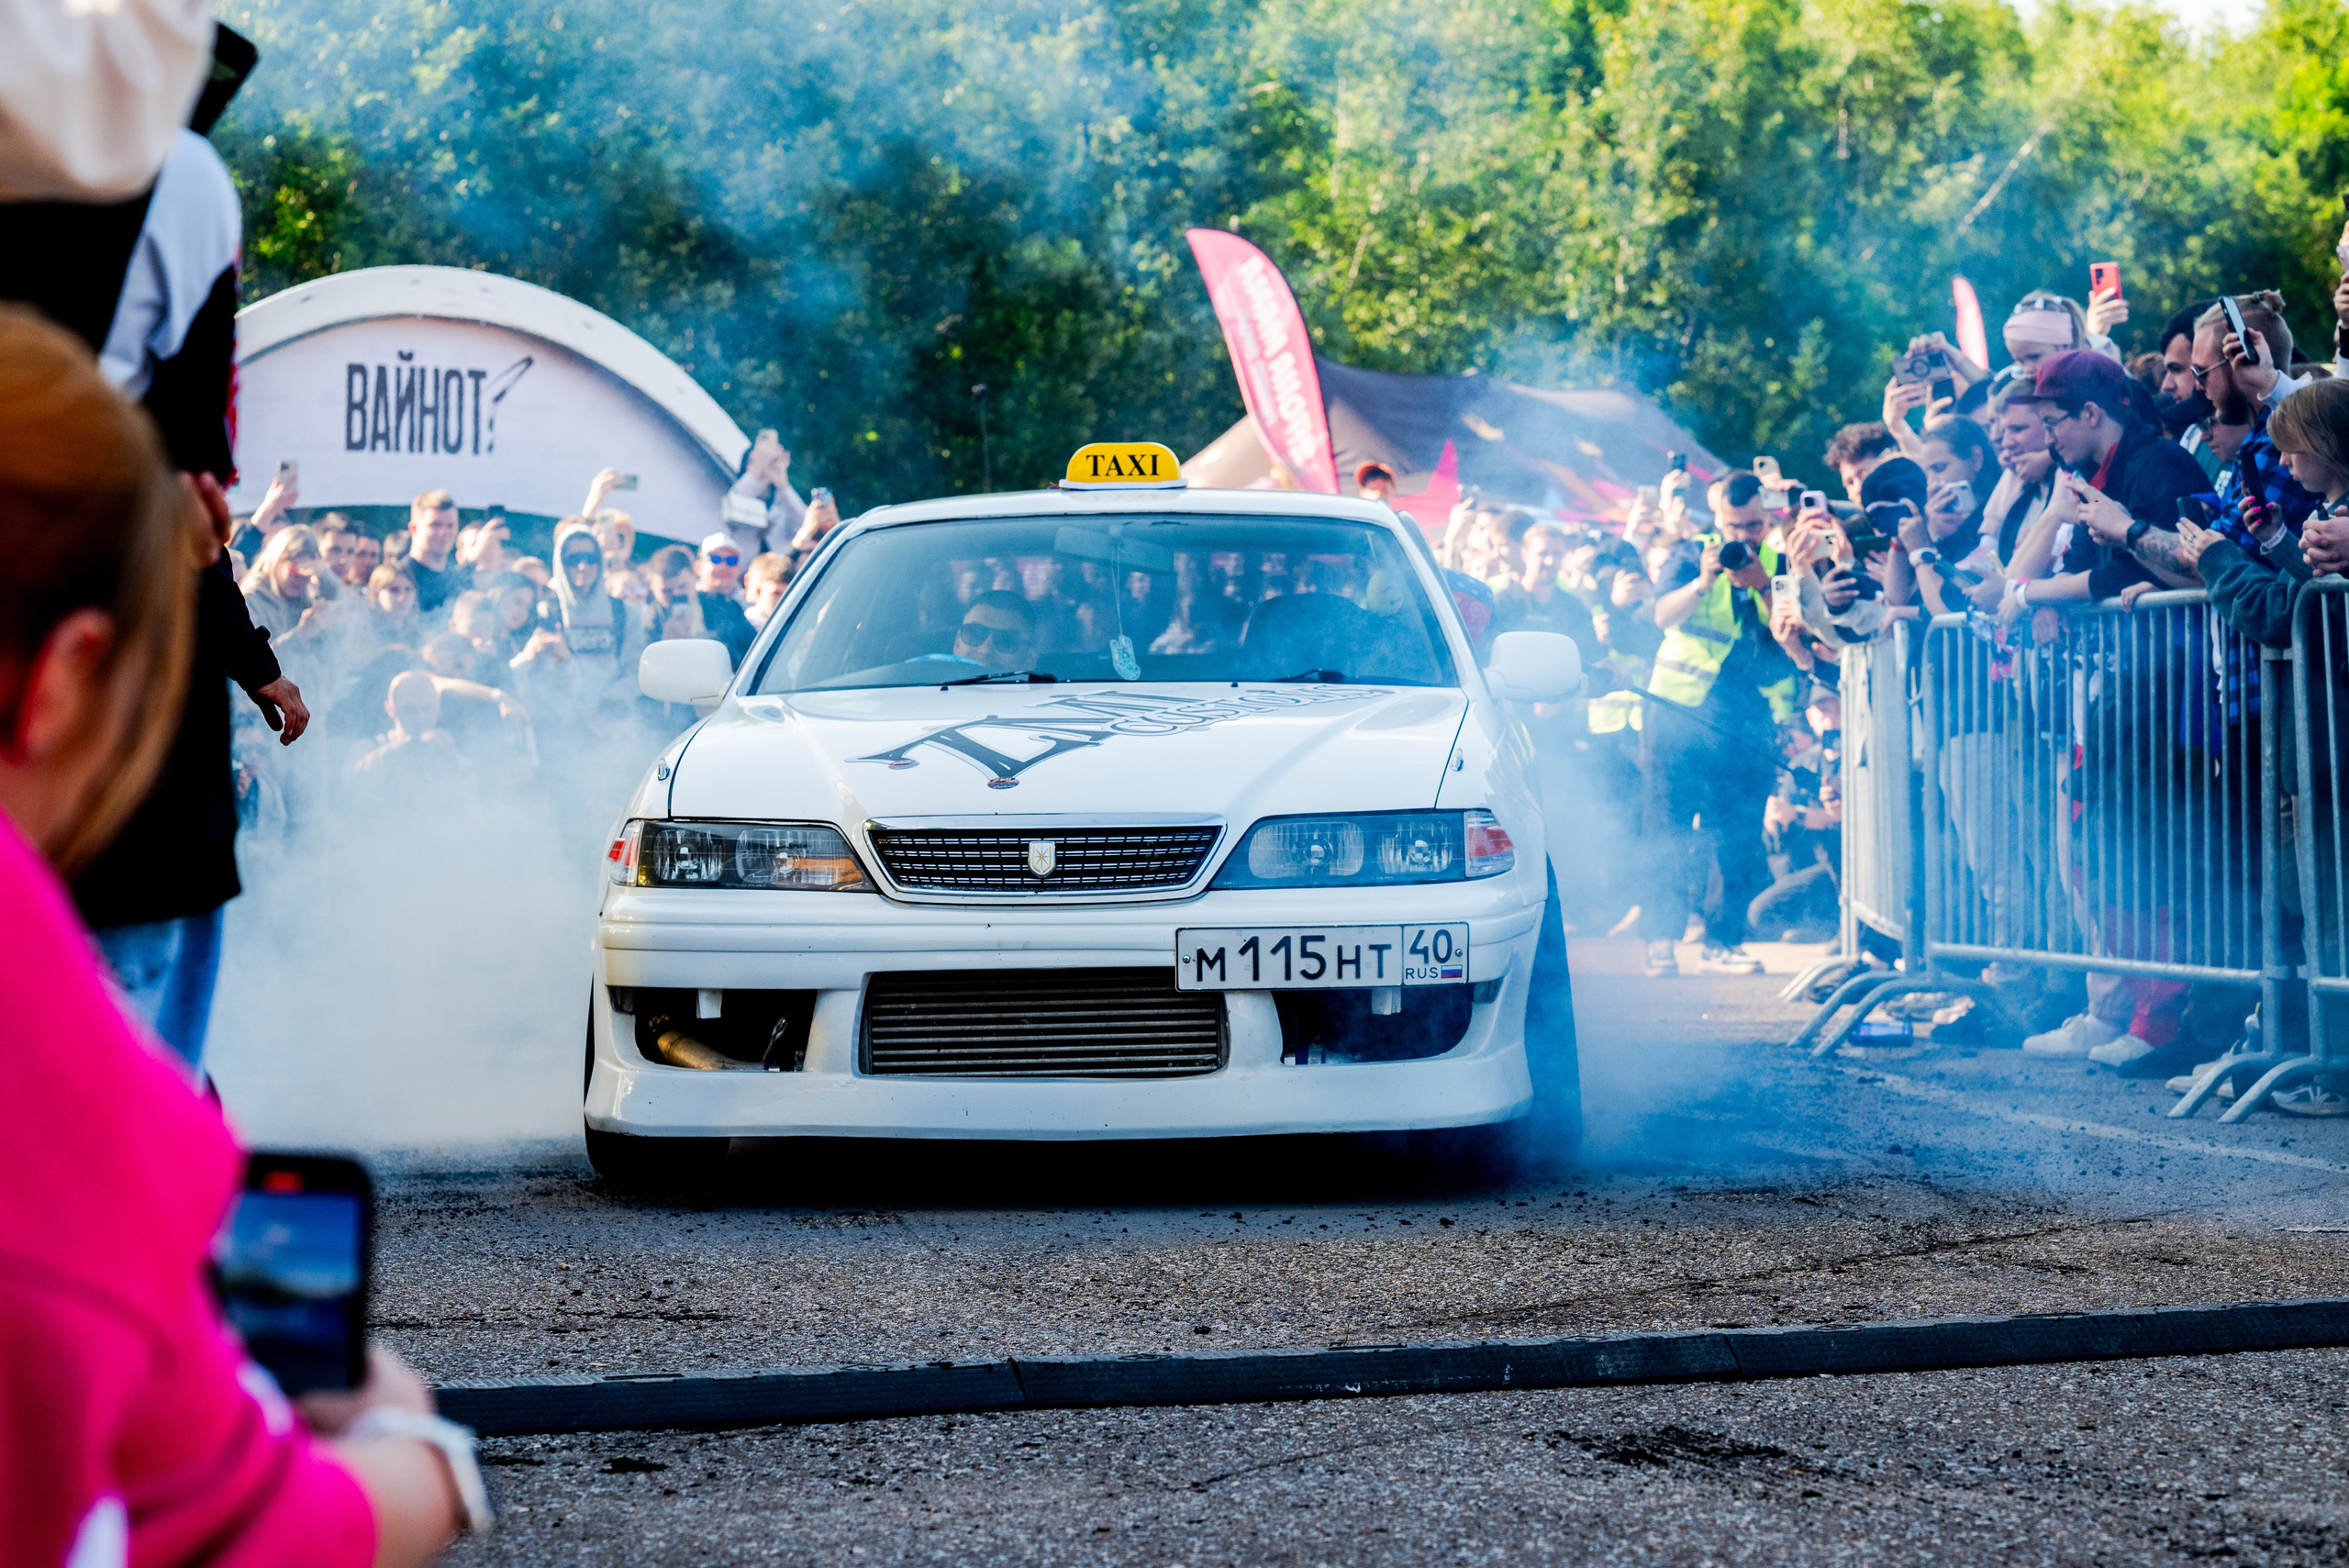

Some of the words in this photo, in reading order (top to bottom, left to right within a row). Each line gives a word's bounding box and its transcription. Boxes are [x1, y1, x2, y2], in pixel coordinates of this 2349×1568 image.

[1085, 454, 1161, 477] TAXI
[1408, 929, 1453, 964] 40
[1405, 966, 1439, 979] RUS
